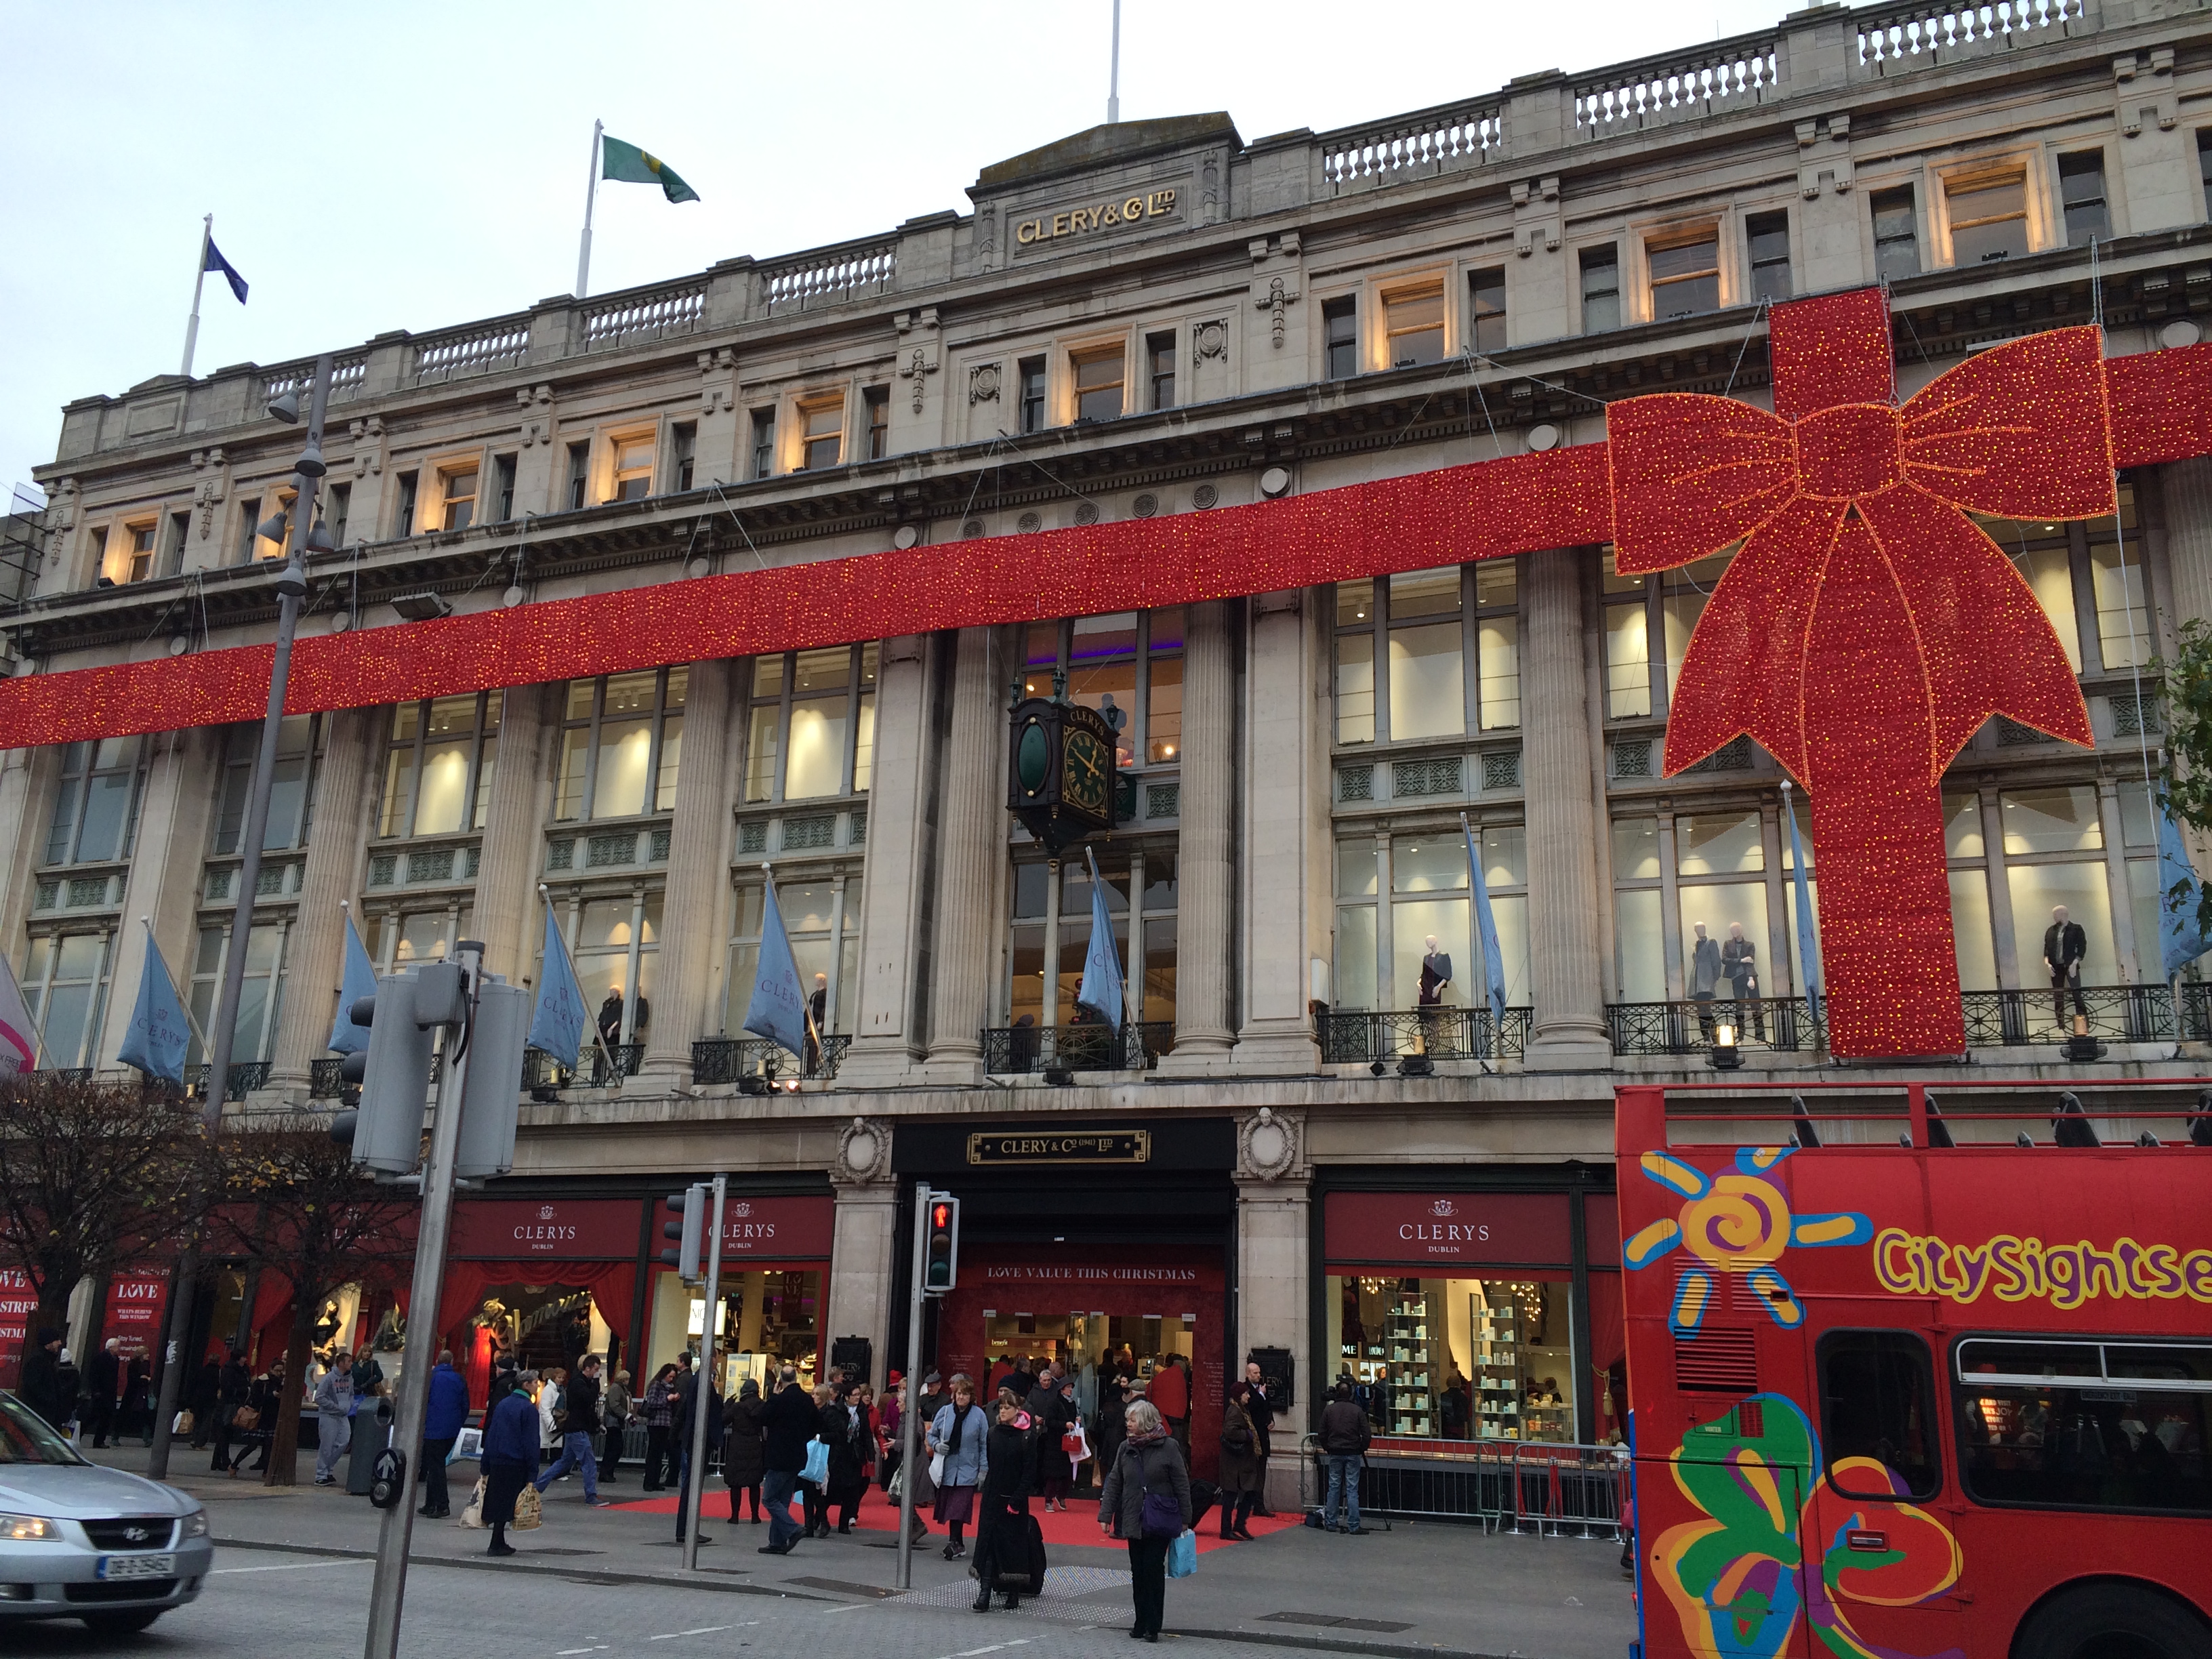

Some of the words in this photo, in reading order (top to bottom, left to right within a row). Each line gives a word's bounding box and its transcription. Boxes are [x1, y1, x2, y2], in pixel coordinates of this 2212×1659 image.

[1070, 710, 1105, 737] CLERYS
[761, 979, 803, 1015] CLERY
[137, 1017, 181, 1046] CERYS
[1001, 1139, 1050, 1153] CLERY
[1051, 1142, 1059, 1151] &
[514, 1226, 575, 1240] CLERYS
[1399, 1224, 1489, 1241] CLERYS
[987, 1267, 1021, 1277] LOVE
[1026, 1267, 1072, 1278] VALUE
[1077, 1268, 1109, 1279] THIS
[1113, 1269, 1195, 1280] CHRISTMAS
[118, 1284, 158, 1298] LOVE
[1996, 1408, 2013, 1416] JOY
